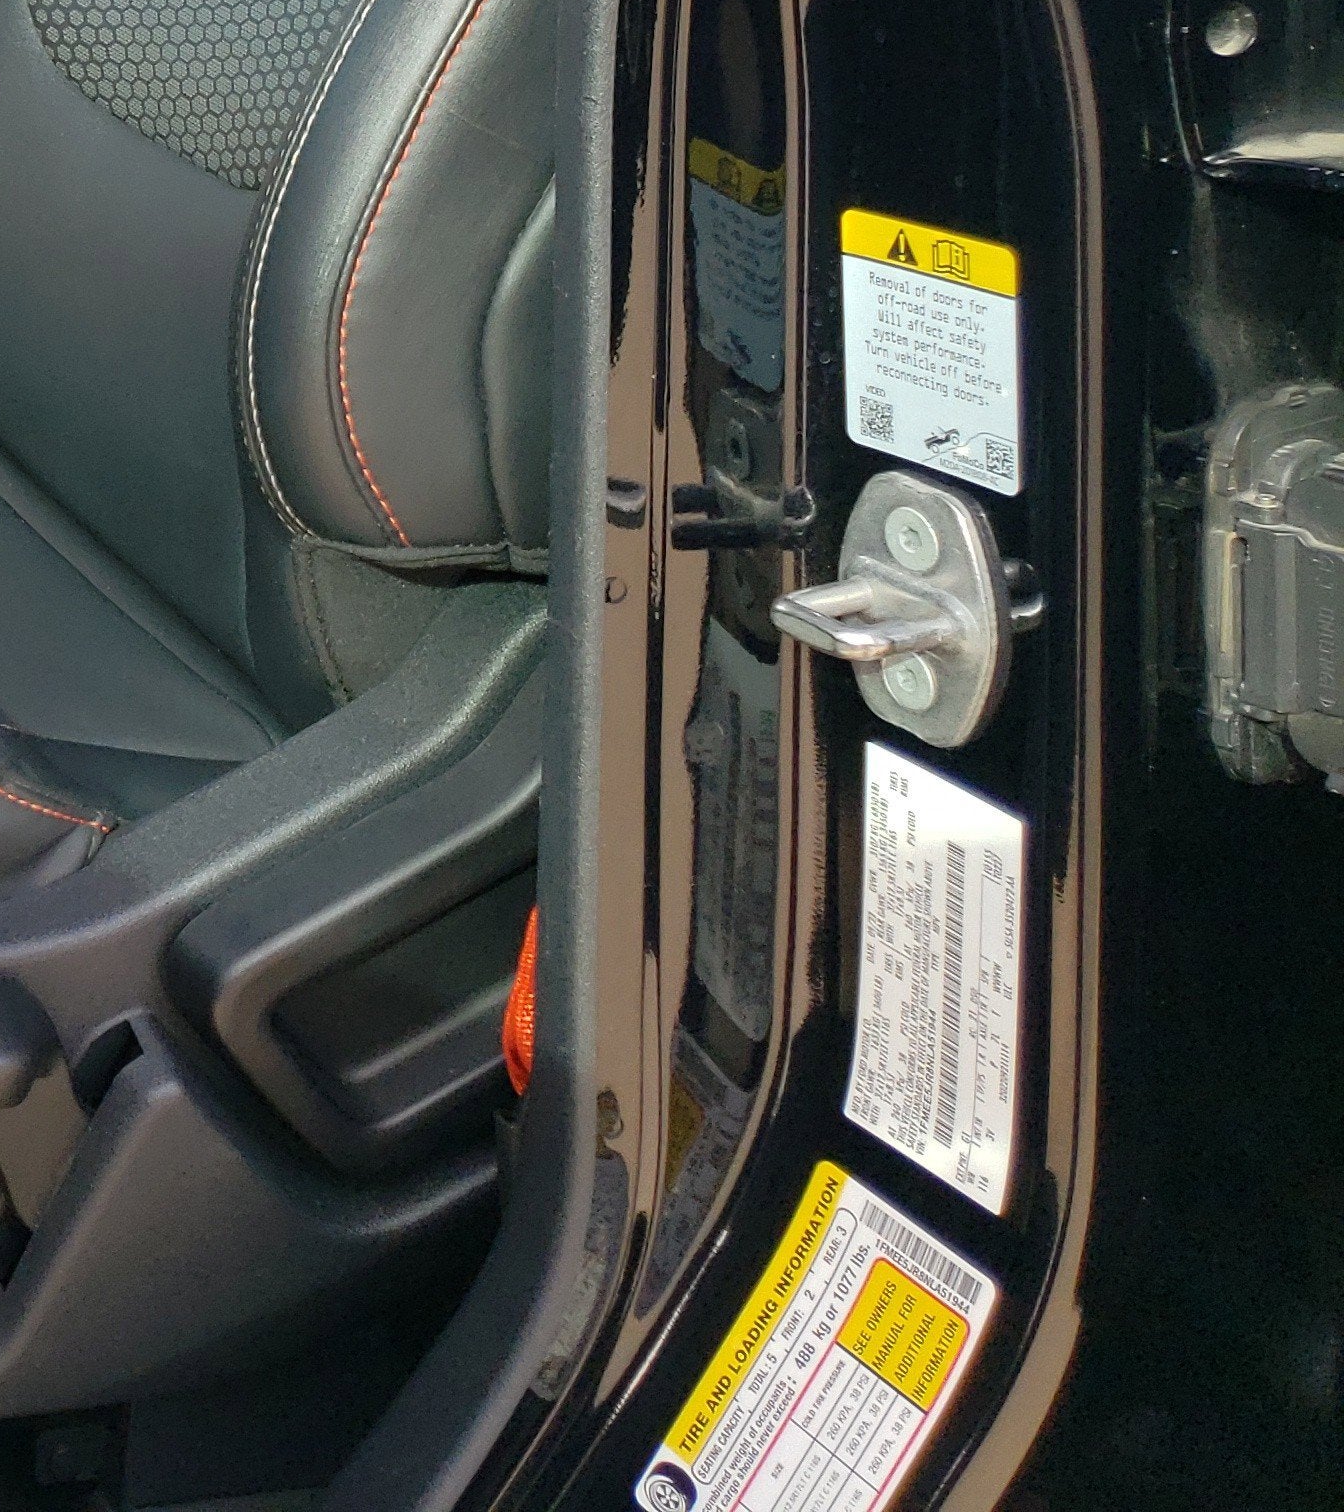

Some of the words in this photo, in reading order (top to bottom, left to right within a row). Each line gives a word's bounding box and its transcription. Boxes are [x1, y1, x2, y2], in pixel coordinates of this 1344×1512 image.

[869, 270, 910, 294] Removal
[914, 283, 926, 299] of
[932, 288, 962, 309] doors
[969, 298, 987, 316] for
[877, 291, 925, 317] off-road
[931, 308, 949, 323] use
[955, 312, 984, 336] only.
[872, 325, 908, 350] system
[877, 309, 901, 327] Will
[907, 317, 943, 339] affect
[949, 329, 985, 355] safety
[864, 339, 888, 359] Turn
[894, 348, 936, 373] vehicle
[941, 362, 958, 380] off
[965, 370, 1002, 394] before
[876, 359, 948, 398] reconnecting
[834, 1224, 848, 1237] 3
[848, 1239, 872, 1268] lbs.
[802, 1288, 816, 1301] 2
[831, 1265, 858, 1303] 1077
[677, 1410, 711, 1454] TIRE
[702, 1372, 734, 1414] AND
[729, 1297, 779, 1375] LOADING
[772, 1174, 840, 1298] INFORMATION
[809, 1317, 833, 1342] kg
[823, 1302, 840, 1321] or
[851, 1329, 872, 1356] SEE
[864, 1278, 898, 1332] OWNERS
[870, 1319, 905, 1371] MANUAL
[897, 1293, 918, 1321] FOR
[765, 1351, 779, 1364] 5
[791, 1340, 817, 1371] 488
[892, 1309, 936, 1383] ADDITIONAL
[910, 1317, 959, 1402] INFORMATION
[696, 1443, 723, 1479] SEATING
[716, 1404, 746, 1447] CAPACITY
[719, 1478, 742, 1508] cargo
[735, 1446, 760, 1481] should
[754, 1419, 777, 1449] never
[770, 1386, 796, 1422] exceed
[725, 1436, 753, 1473] weight
[745, 1425, 759, 1440] of
[752, 1378, 789, 1429] occupants
